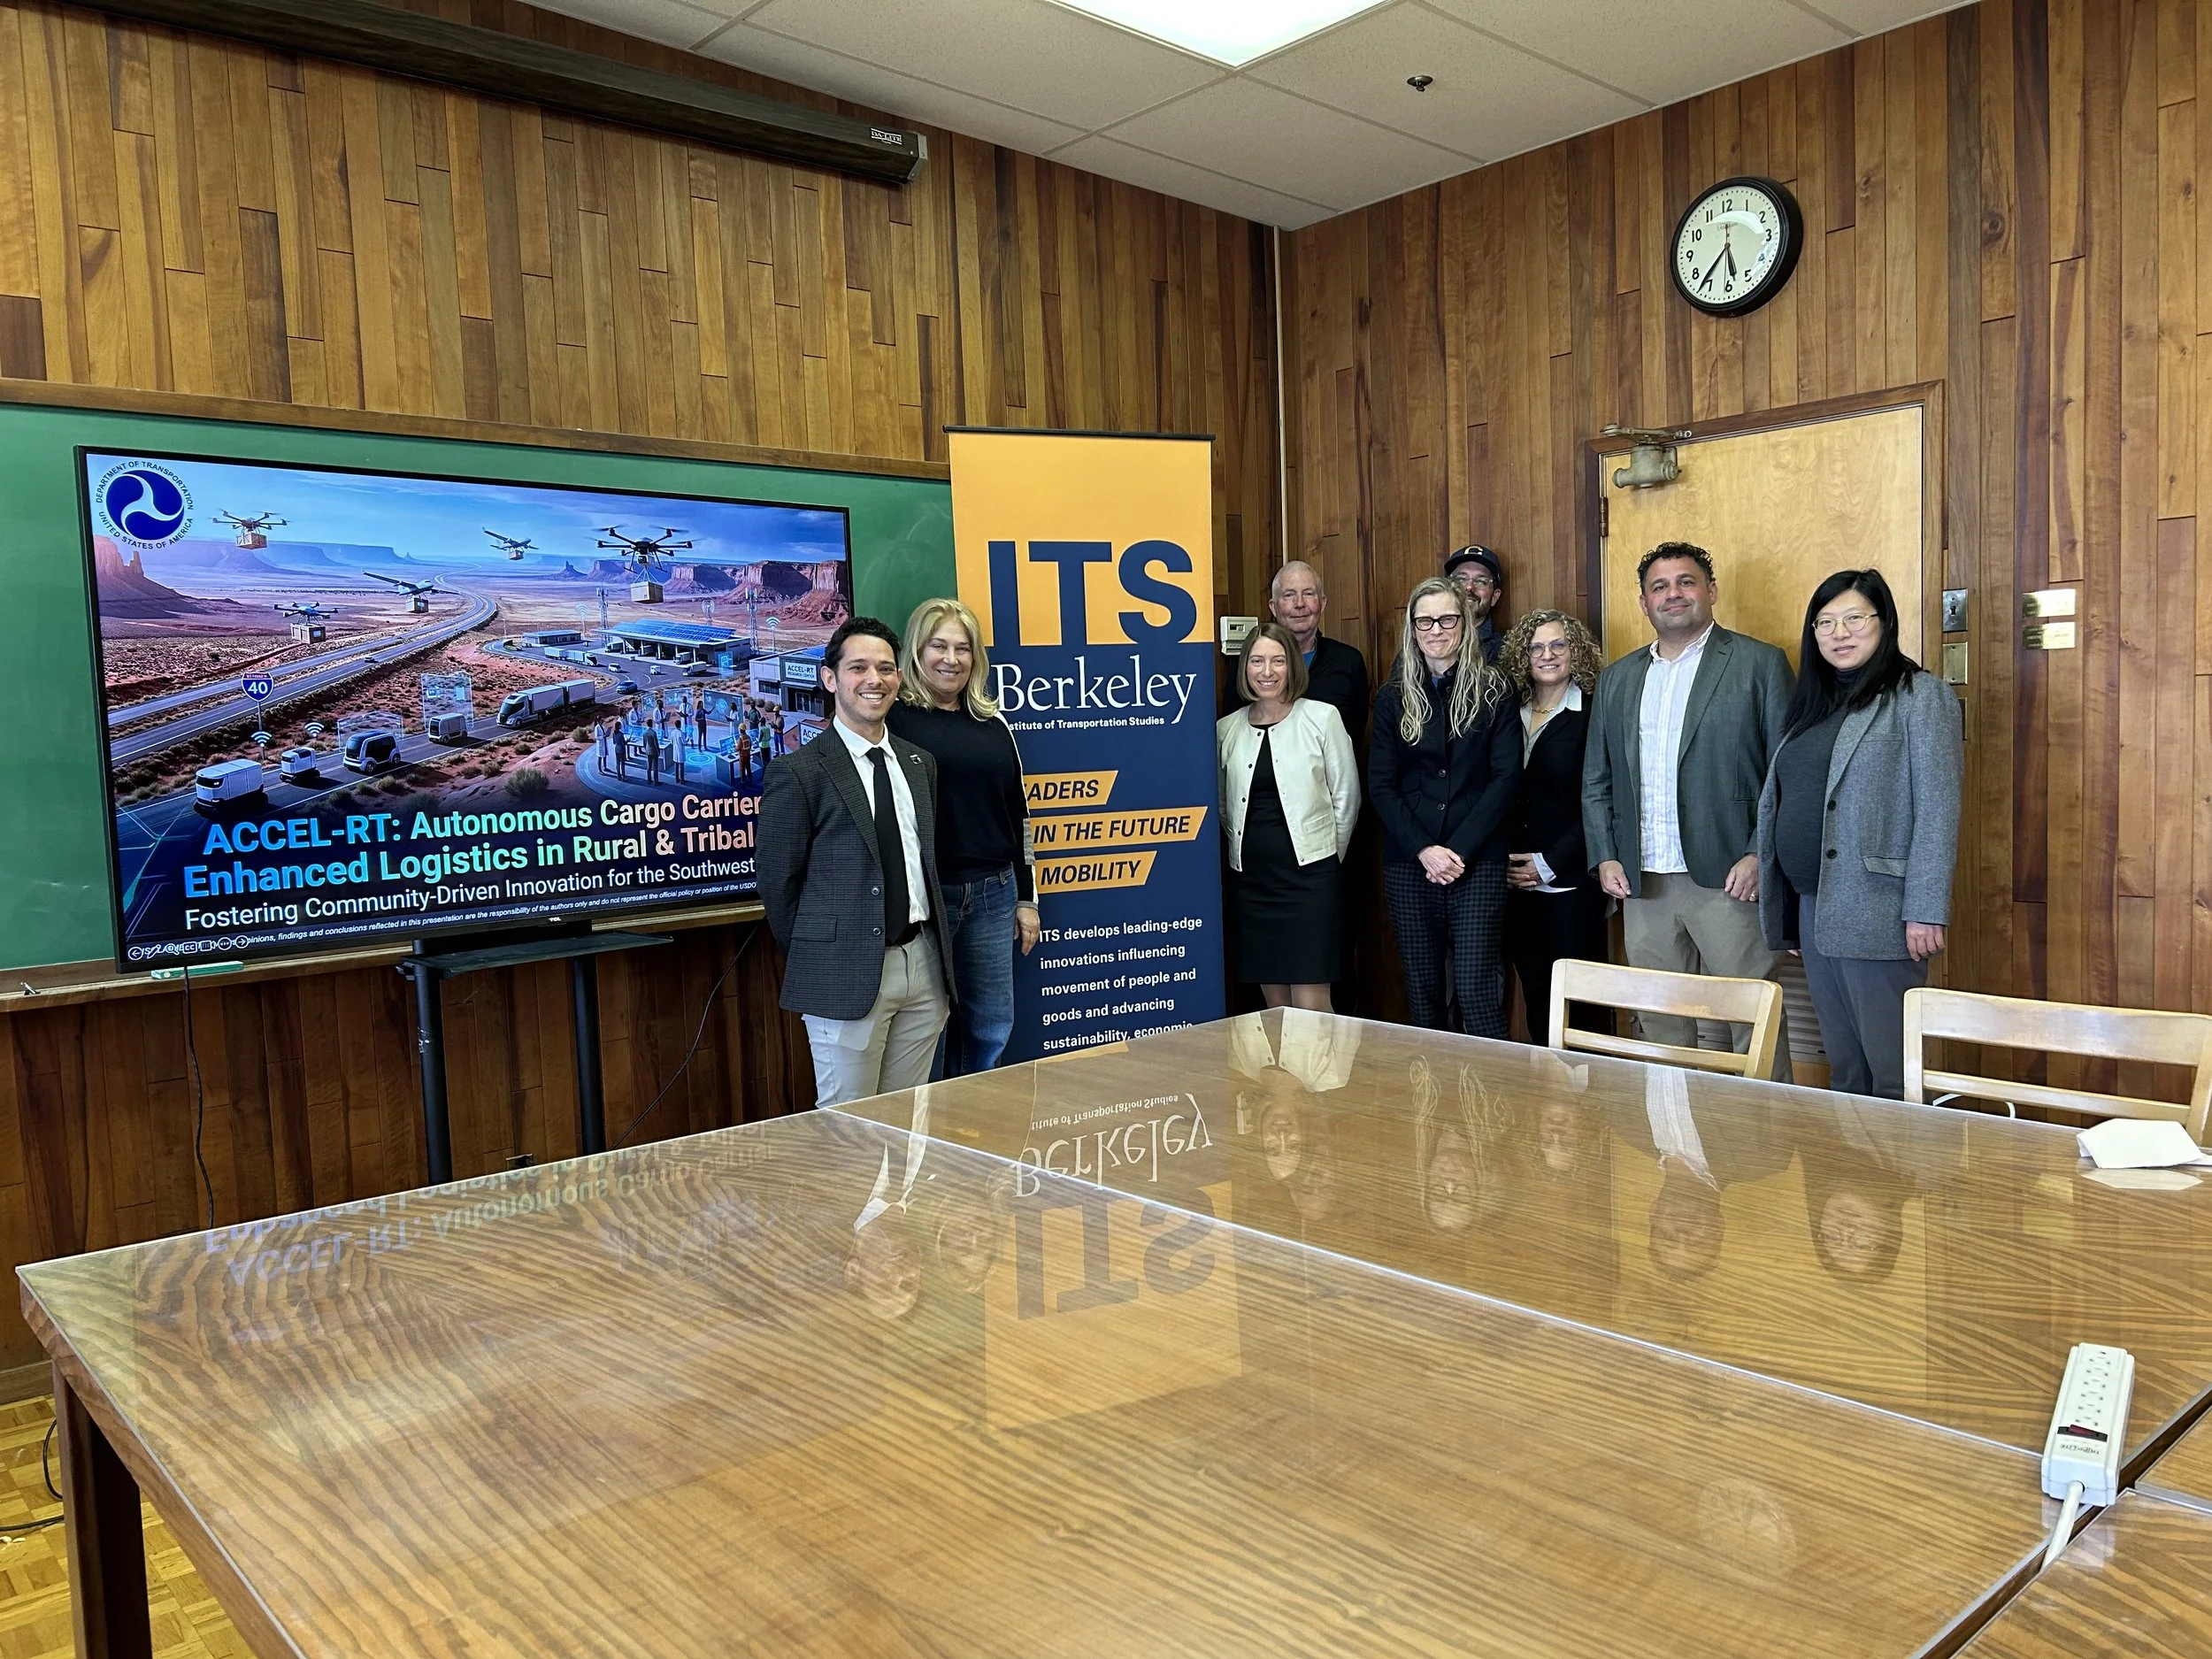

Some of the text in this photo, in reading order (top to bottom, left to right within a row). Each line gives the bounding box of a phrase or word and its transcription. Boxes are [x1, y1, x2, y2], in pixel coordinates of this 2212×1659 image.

[1722, 199, 1732, 213] 12
[1745, 199, 1748, 211] 1
[1706, 210, 1713, 223] 11
[1759, 211, 1766, 223] 2
[1692, 229, 1702, 242] 10
[1765, 229, 1772, 242] 3
[1686, 250, 1694, 262] 9
[1692, 267, 1700, 280] 8
[1745, 270, 1752, 282] 5
[1706, 279, 1713, 292] 7
[1725, 280, 1732, 292] 6
[96, 463, 127, 503] DEPARTMENT
[142, 461, 194, 510] TRANSPORTATION
[99, 511, 120, 538] UNITED
[121, 536, 153, 549] STATES
[169, 518, 193, 545] AMERICA
[988, 540, 1197, 646] ITS
[248, 681, 268, 694] 40
[990, 654, 1197, 724] Berkeley
[803, 729, 818, 739] ACC
[1009, 716, 1165, 731] stitute of Transportation Studies
[1024, 780, 1100, 802] ADERS
[203, 813, 401, 856] ACCEL-RT:
[410, 806, 593, 840] Autonomous
[600, 799, 676, 829] Cargo
[1033, 816, 1191, 844] IN THE FUTURE
[183, 821, 754, 898] Enhanced Logistics in Rural & Tribal
[1041, 859, 1141, 886] MOBILITY
[185, 856, 756, 930] Fostering Community-Driven Innovation for the Southwest
[247, 934, 276, 945] pinions,
[278, 932, 308, 941] findings
[325, 925, 367, 935] conclusions
[368, 920, 399, 931] reflected
[422, 914, 464, 926] presentation
[488, 906, 531, 918] responsibility
[550, 901, 574, 910] authors
[621, 894, 649, 904] represent
[659, 890, 678, 899] official
[678, 888, 695, 897] policy
[702, 886, 723, 895] position
[1039, 917, 1202, 943] ITS develops leading-edge
[1040, 944, 1186, 970] innovations influencing
[1041, 967, 1196, 996] movement of people and
[1042, 998, 1175, 1026] goods and advancing
[1043, 1030, 1131, 1050] sustainability,
